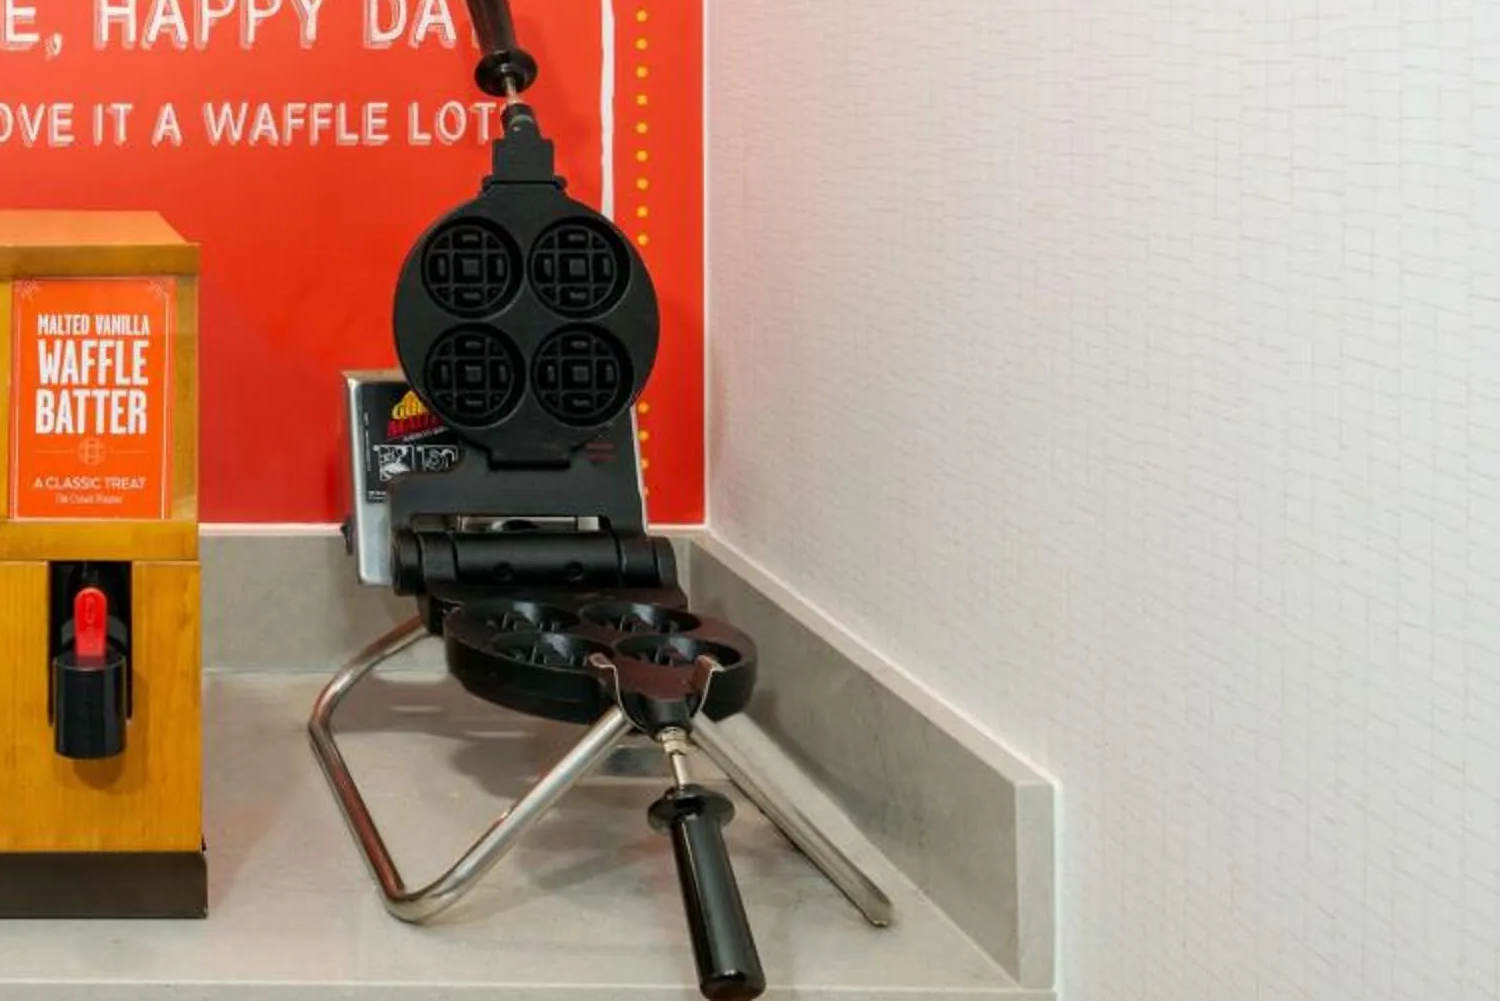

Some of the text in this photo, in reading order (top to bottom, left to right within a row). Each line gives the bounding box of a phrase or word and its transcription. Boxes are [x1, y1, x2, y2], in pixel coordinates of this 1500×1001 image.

[93, 102, 133, 146] IT
[151, 102, 184, 146] A
[203, 101, 389, 147] WAFFLE
[407, 100, 507, 147] LOT
[37, 313, 150, 336] MALTED VANILLA
[37, 339, 149, 386] WAFFLE
[35, 388, 148, 435] BATTER
[33, 476, 147, 490] A CLASSIC TREAT
